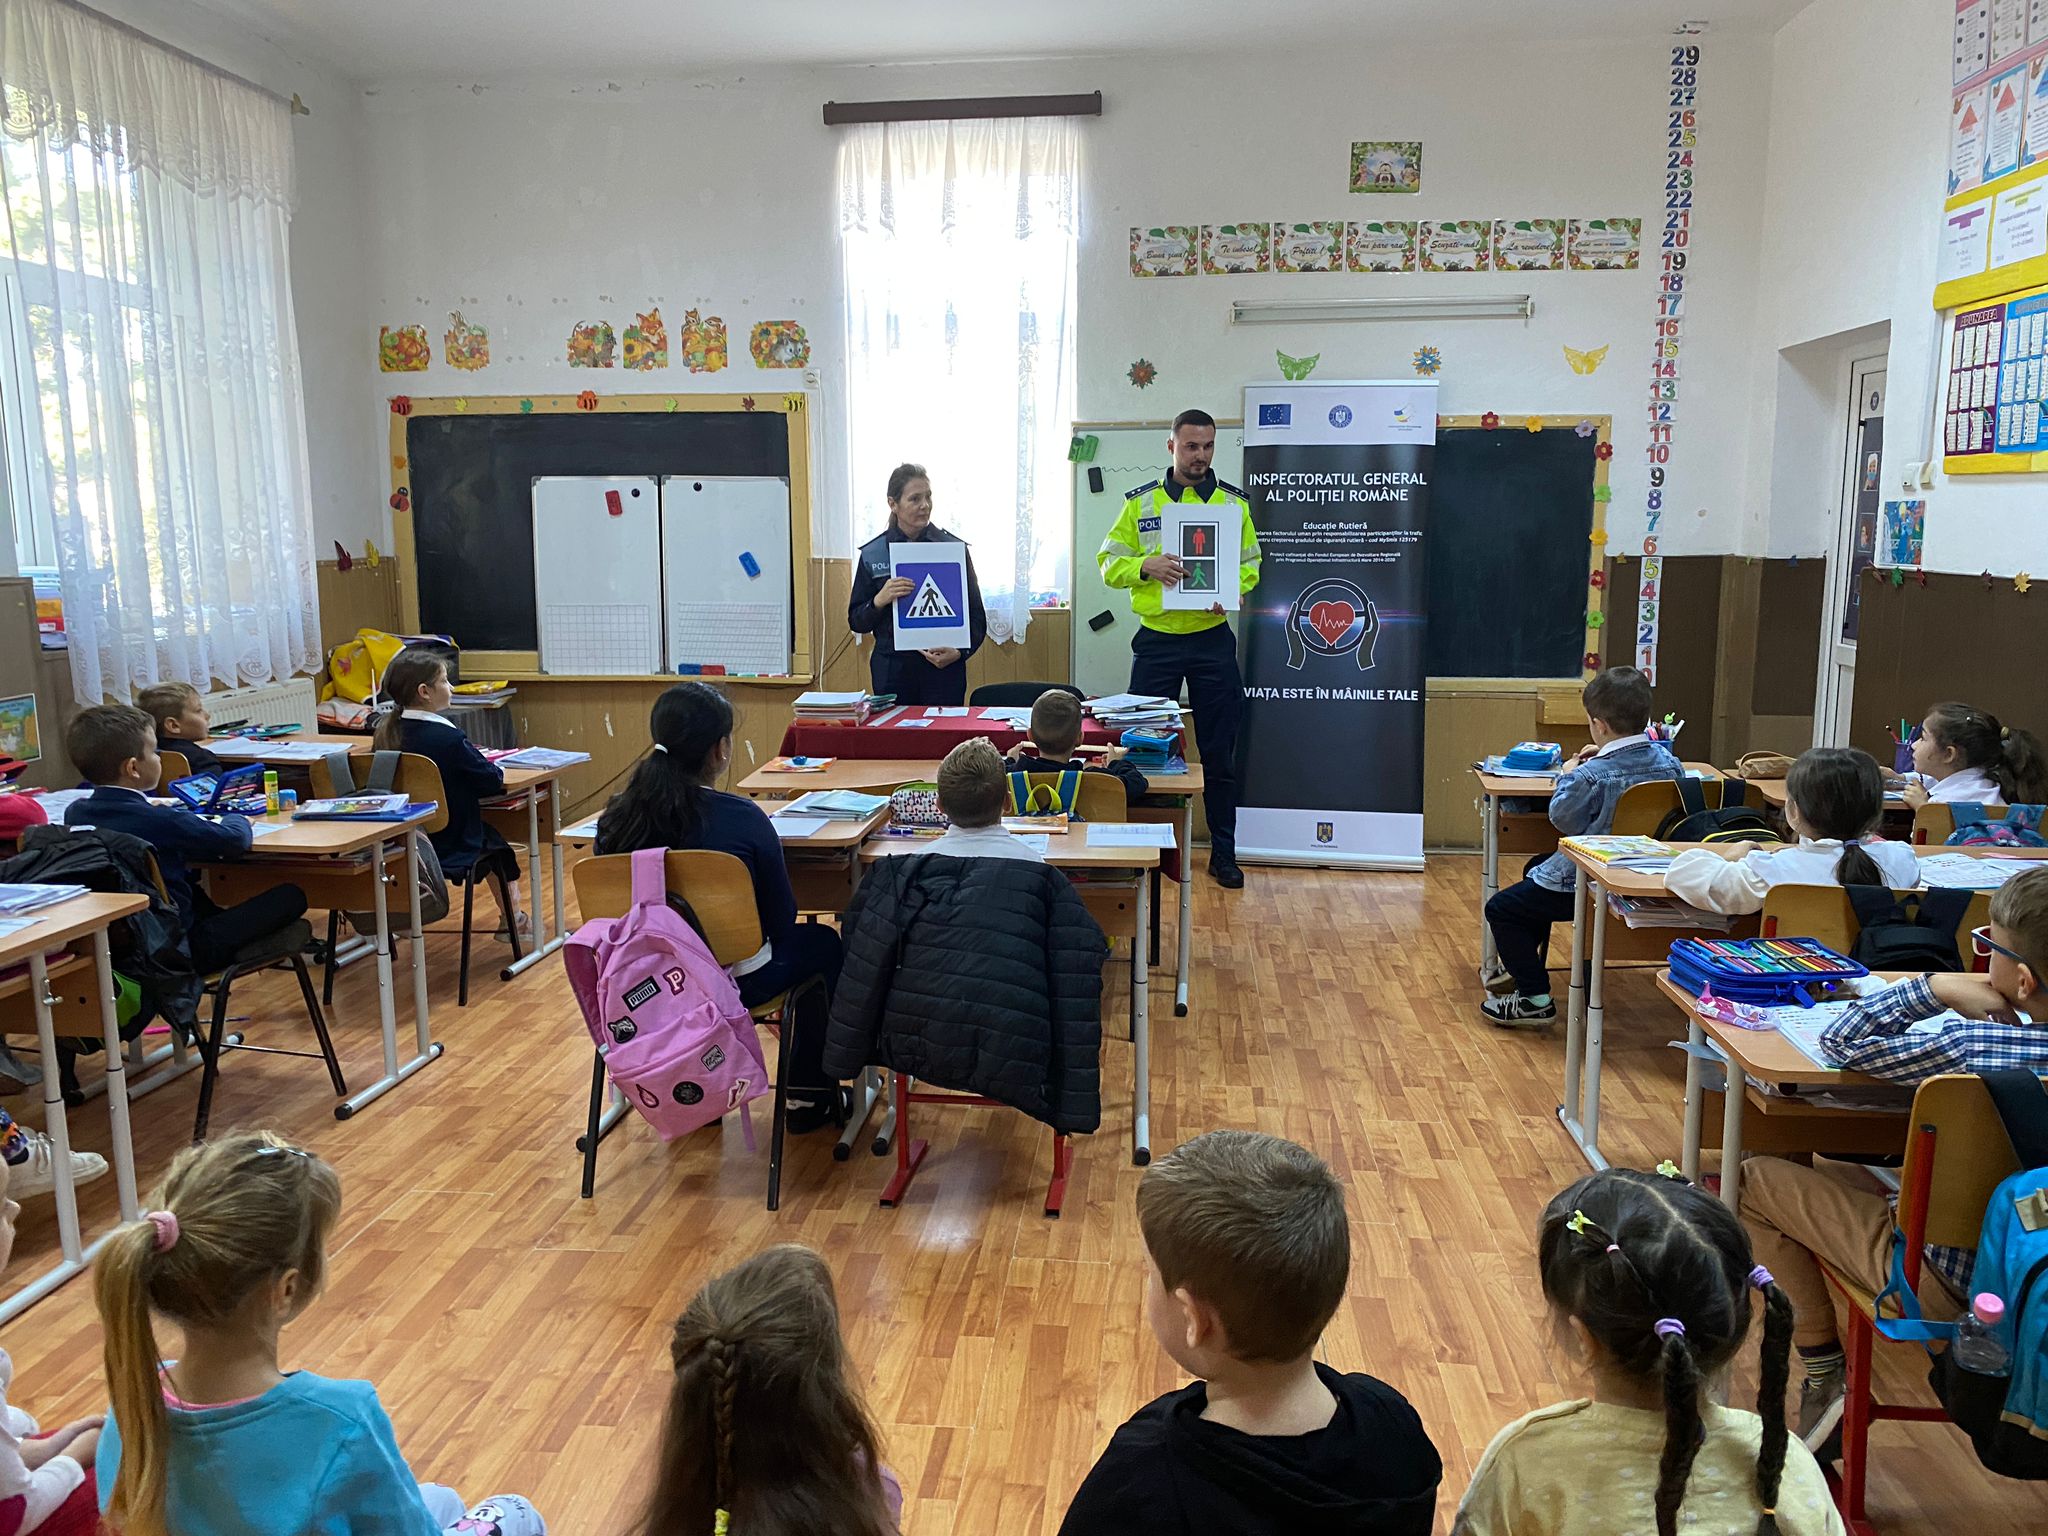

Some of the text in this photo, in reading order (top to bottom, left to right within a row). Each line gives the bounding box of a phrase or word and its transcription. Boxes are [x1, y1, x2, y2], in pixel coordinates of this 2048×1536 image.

[1671, 46, 1700, 66] 29
[1671, 67, 1696, 86] 28
[1670, 87, 1696, 106] 27
[1669, 110, 1695, 128] 26
[1668, 129, 1696, 148] 25
[1667, 150, 1693, 168] 24
[1665, 170, 1692, 189] 23
[1666, 190, 1692, 208] 22
[1666, 209, 1689, 228] 21
[1662, 230, 1688, 247] 20
[1662, 251, 1686, 271] 19
[1660, 272, 1683, 292] 18
[1658, 294, 1682, 315] 17
[1656, 318, 1678, 337] 16
[1960, 308, 1998, 328] ADUNAREA
[1655, 338, 1678, 358] 15
[1652, 359, 1676, 377] 14
[1650, 380, 1676, 400] 13
[1648, 402, 1671, 421] 12
[1650, 423, 1672, 442] 11
[1646, 444, 1669, 463] 10
[1250, 472, 1427, 486] INSPECTORATUL GENERAL
[1650, 467, 1664, 487] 9
[1266, 486, 1408, 505] AL POLIȚIEI ROMÂNE
[1648, 489, 1662, 510] 8
[1139, 520, 1160, 530] POLI
[1339, 522, 1368, 530] Rutieră
[1647, 511, 1661, 531] 7
[1644, 535, 1658, 555] 6
[1644, 558, 1658, 579] 5
[1641, 580, 1656, 600] 4
[1642, 603, 1655, 622] 3
[1639, 624, 1652, 643] 2
[1642, 646, 1651, 666] 1
[1244, 686, 1418, 701] VIAȚA ESTE ÎN MÂINILE TALE
[667, 971, 682, 991] P
[630, 985, 655, 1006] PUMA
